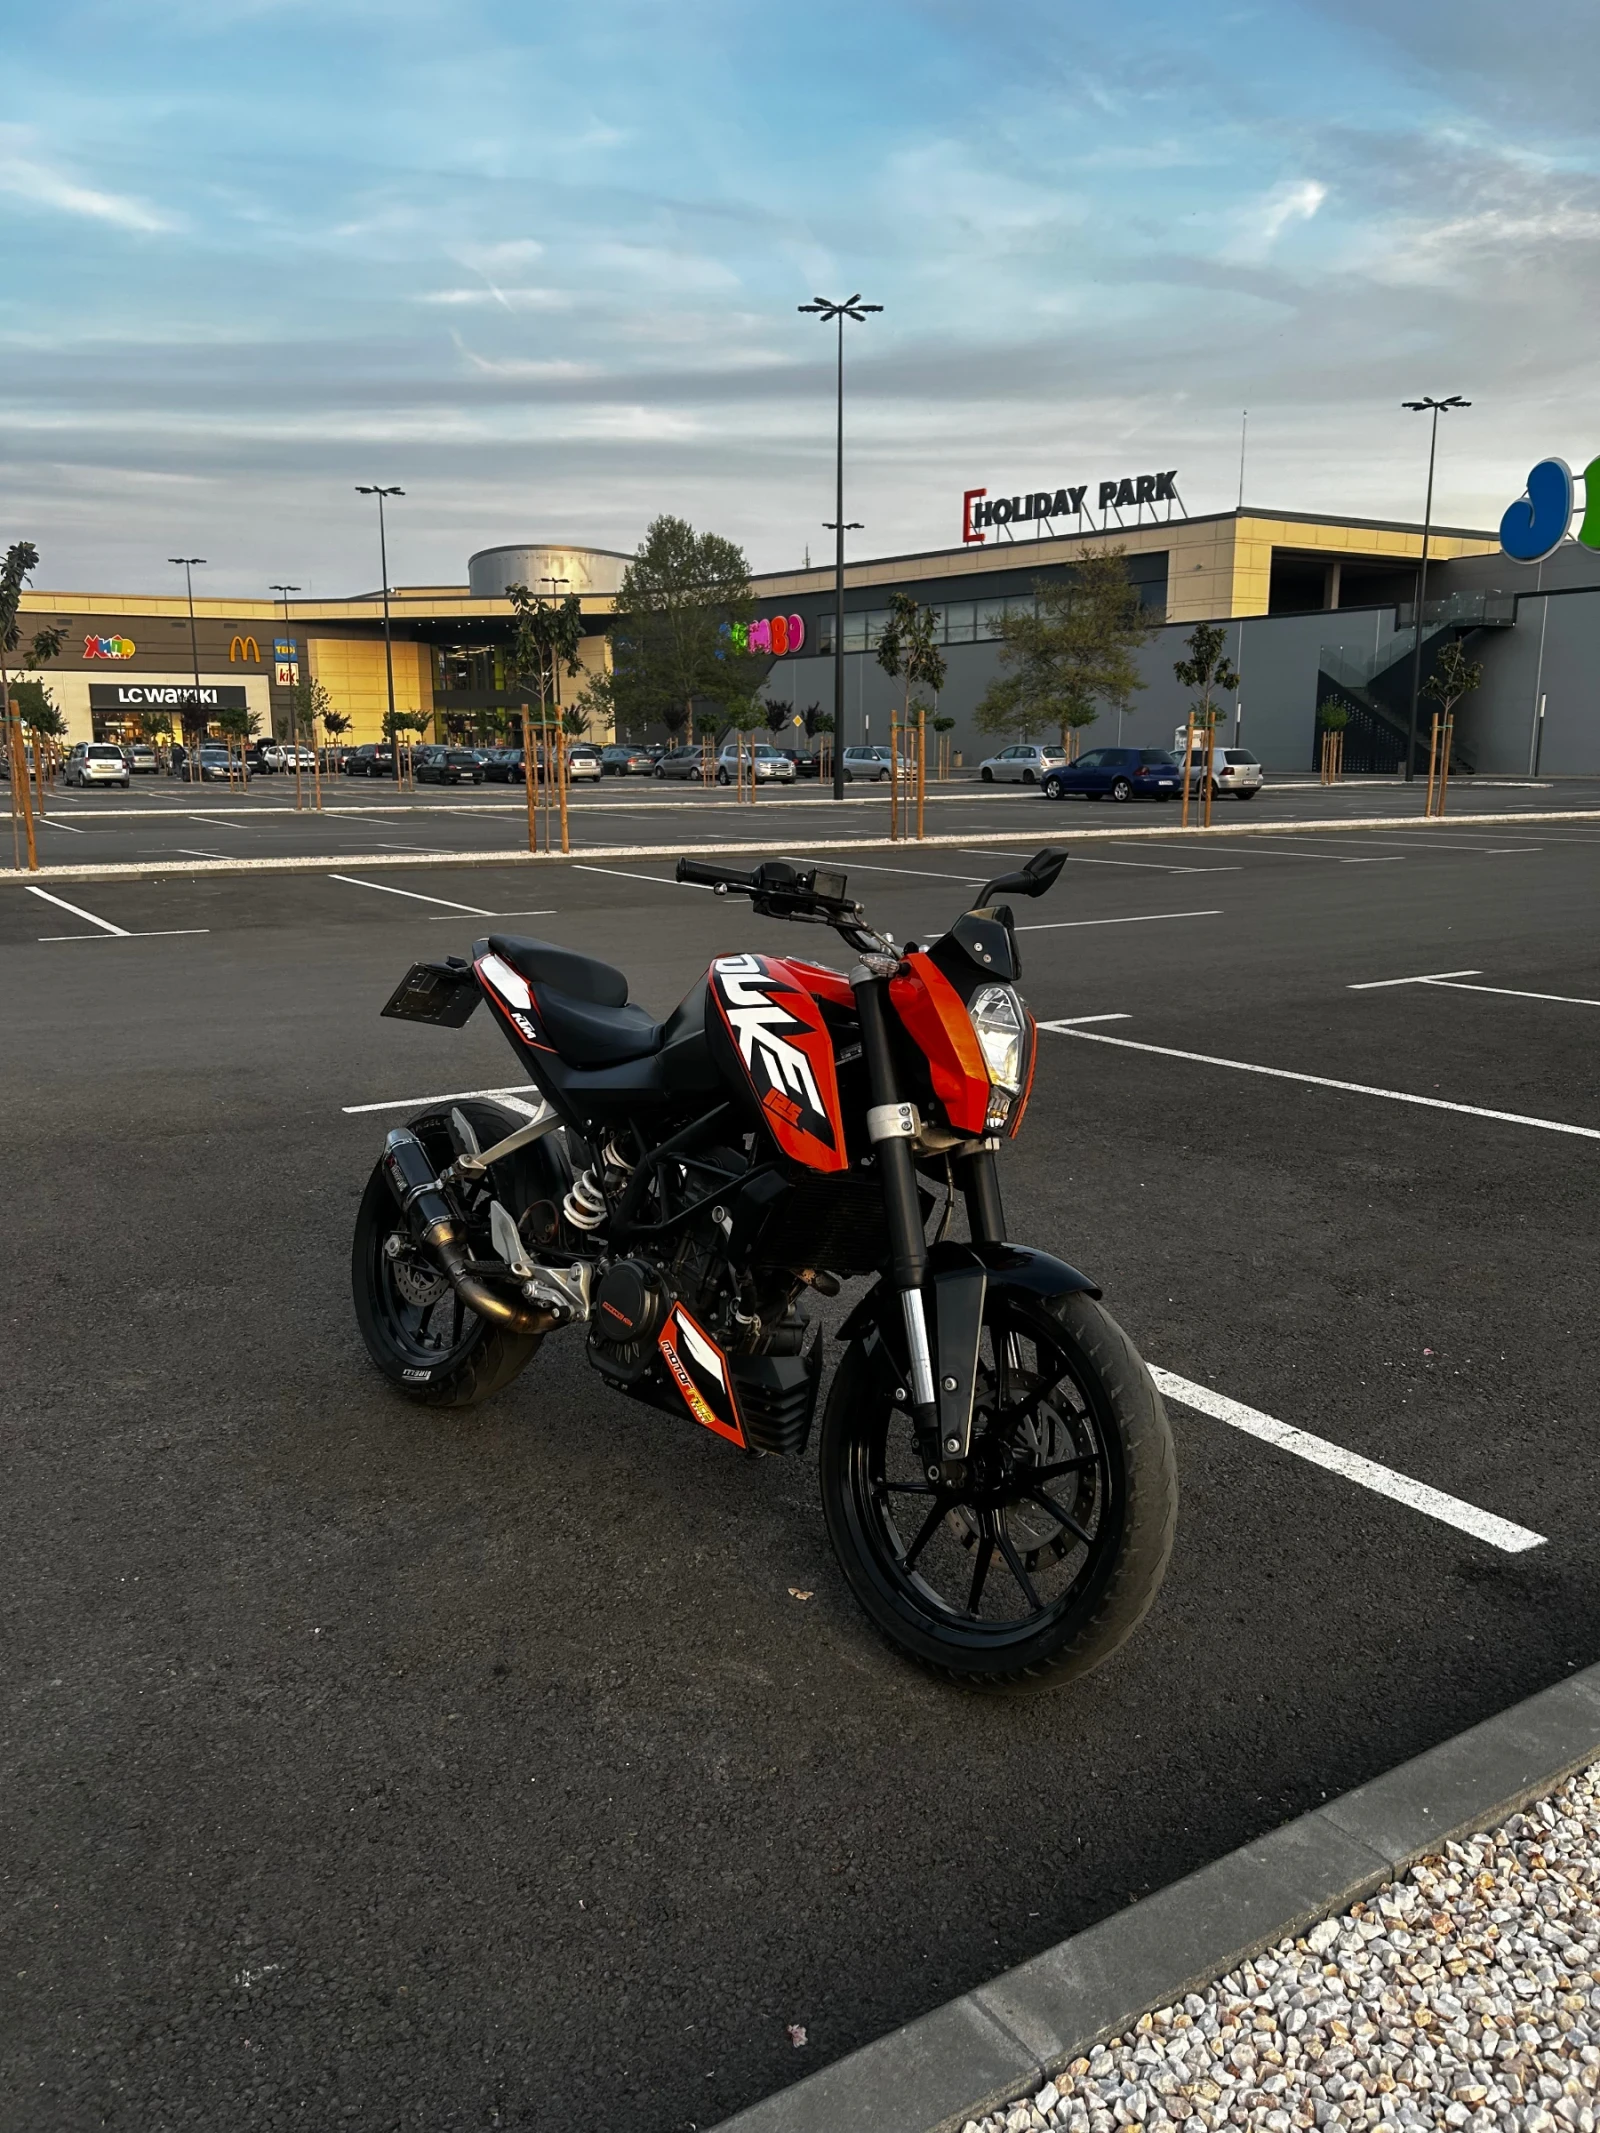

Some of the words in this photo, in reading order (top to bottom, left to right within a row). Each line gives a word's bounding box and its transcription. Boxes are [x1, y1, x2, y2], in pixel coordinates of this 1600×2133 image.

[974, 485, 1087, 528] HOLIDAY
[1098, 470, 1177, 509] PARK
[1499, 455, 1600, 565] J
[118, 688, 143, 703] LC
[511, 1012, 537, 1040] KTM
[714, 953, 826, 1119] DUKE
[762, 1087, 803, 1127] 125
[402, 1368, 432, 1381] PIRELLI
